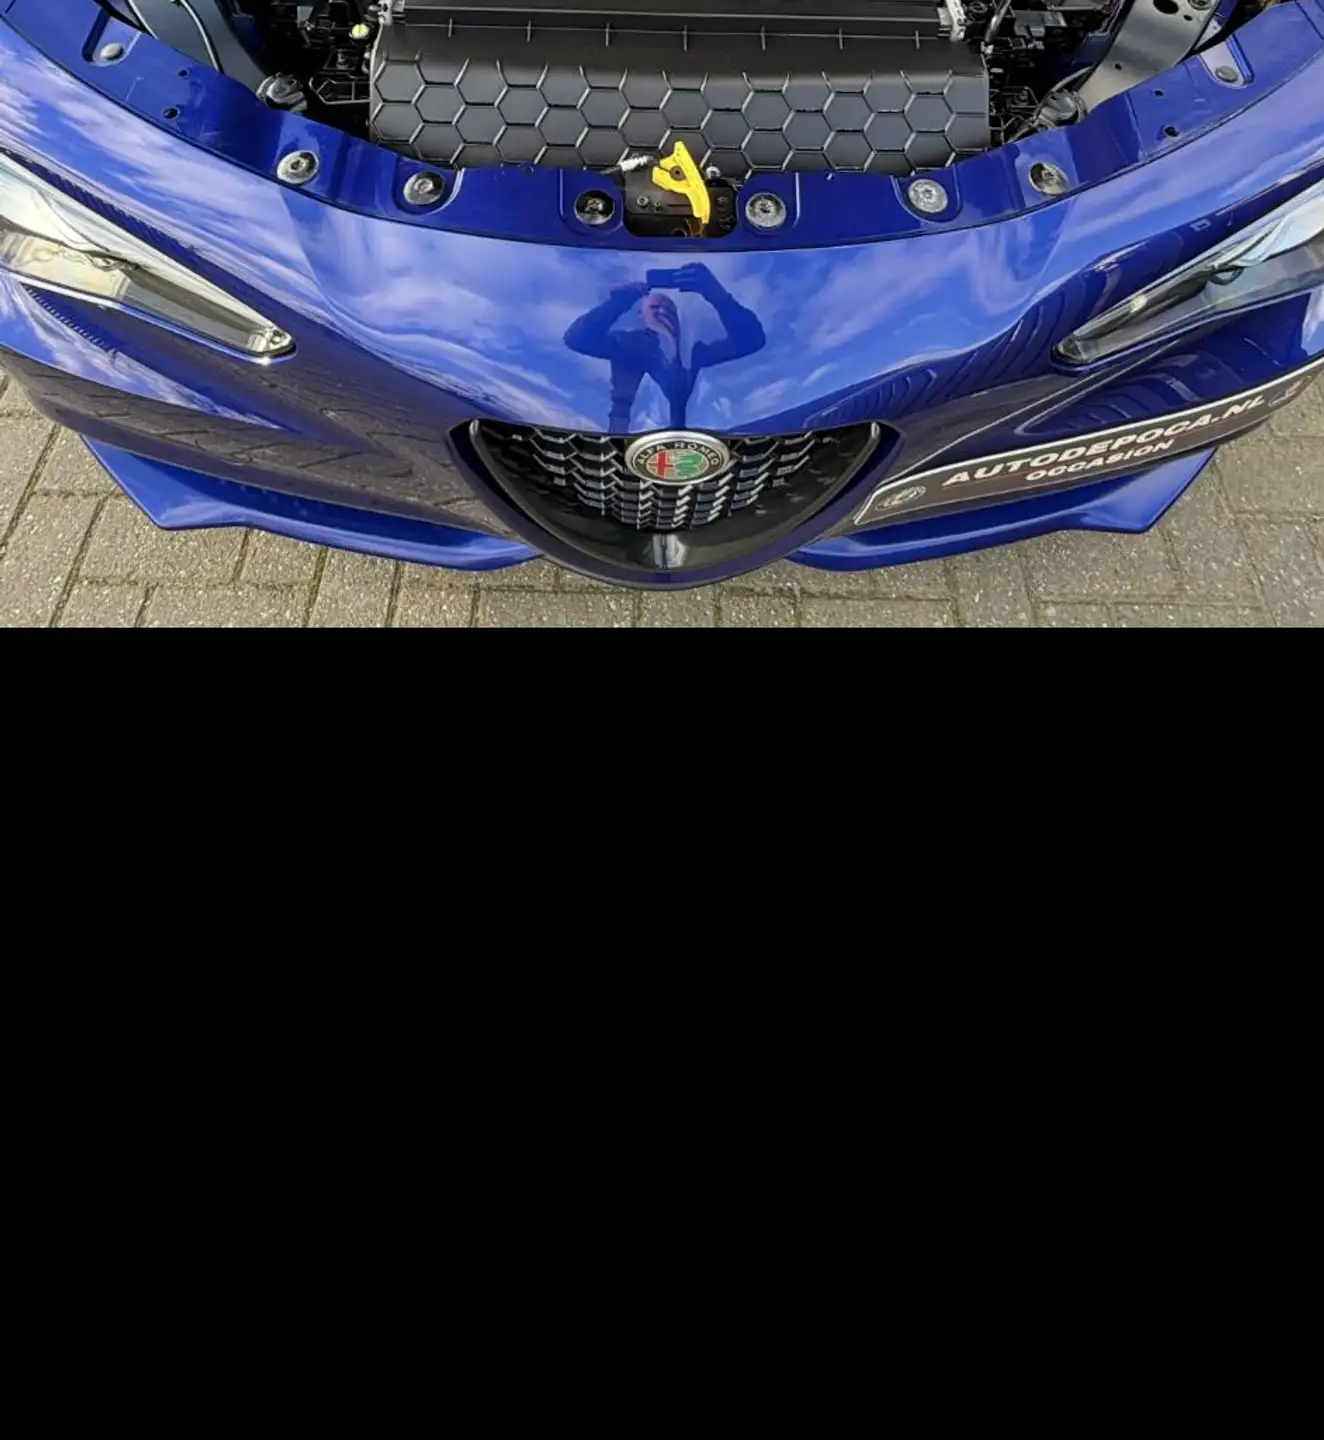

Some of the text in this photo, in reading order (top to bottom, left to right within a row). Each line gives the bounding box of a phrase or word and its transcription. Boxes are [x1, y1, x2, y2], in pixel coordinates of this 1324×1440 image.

[637, 442, 720, 466] ALFA ROMEO
[941, 395, 1265, 487] AUTODEPOCA.NL
[1025, 439, 1175, 481] OCCASION
